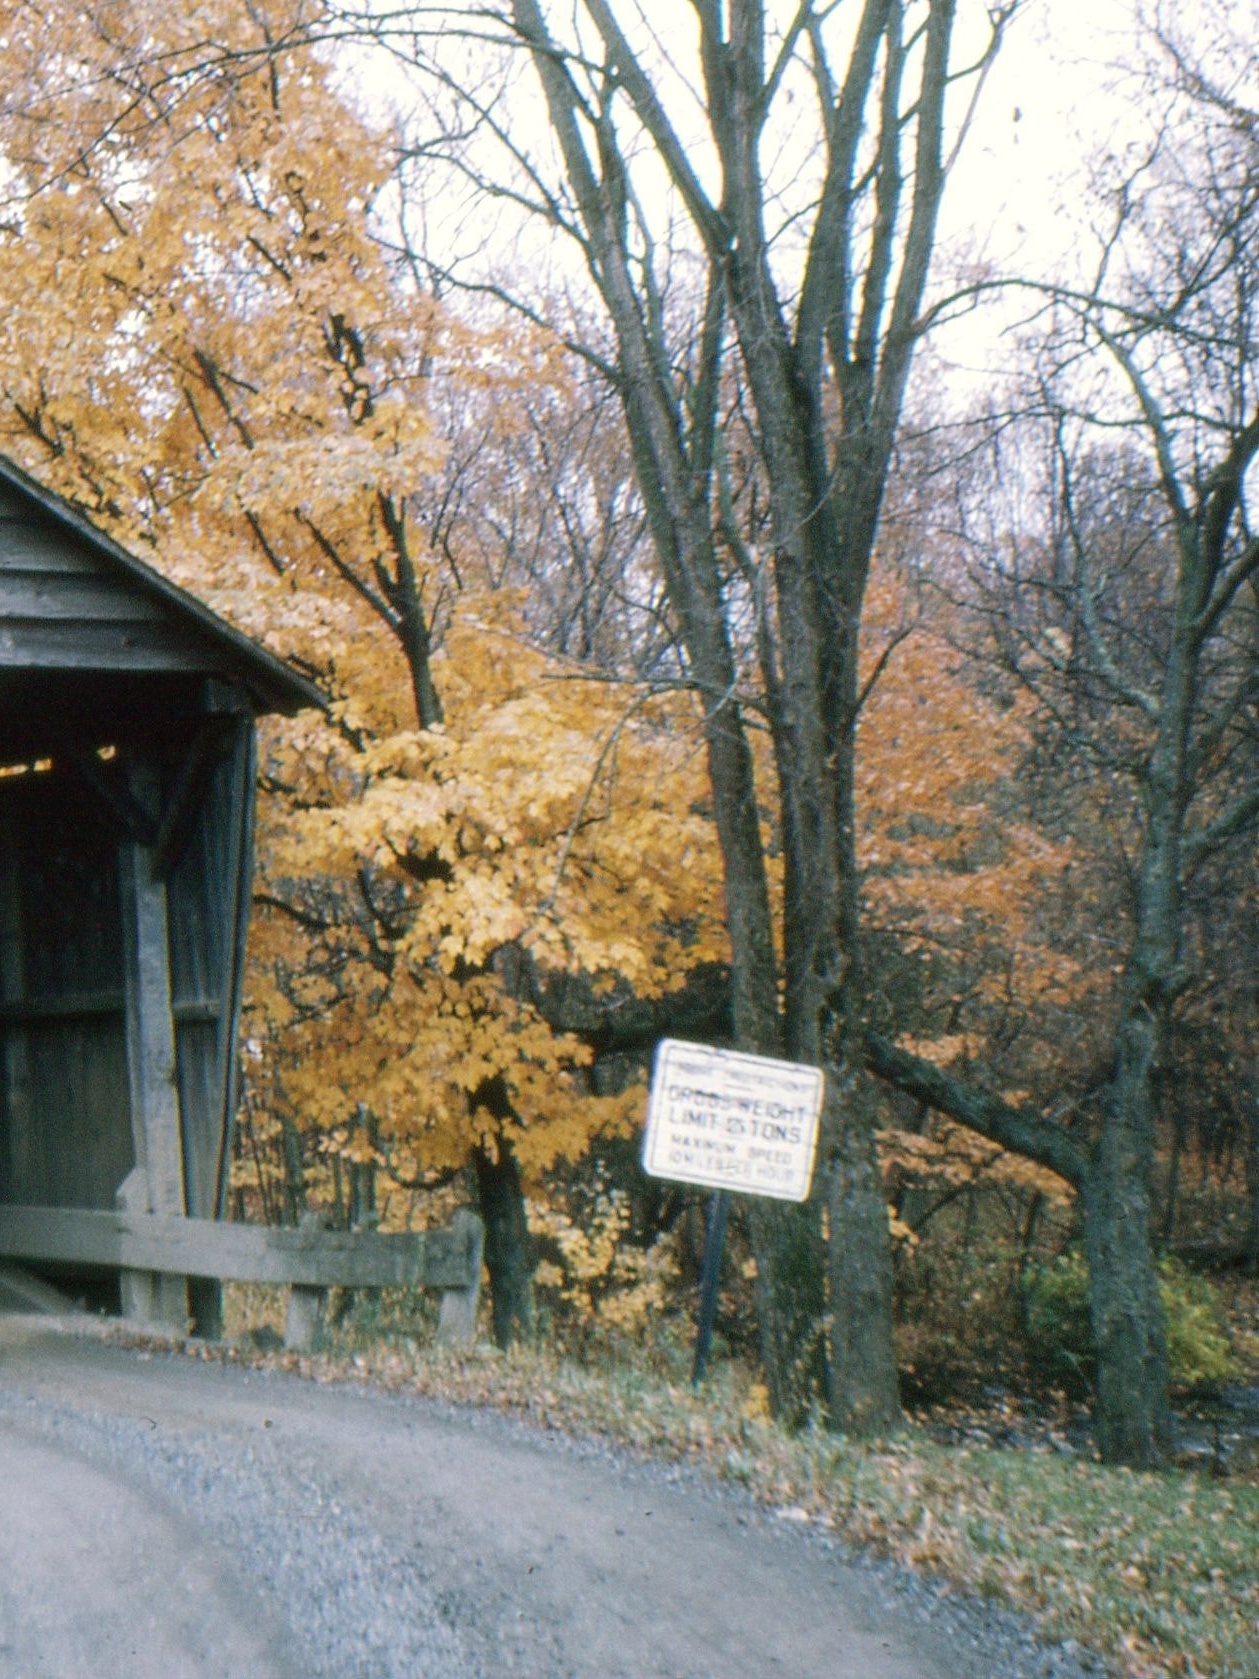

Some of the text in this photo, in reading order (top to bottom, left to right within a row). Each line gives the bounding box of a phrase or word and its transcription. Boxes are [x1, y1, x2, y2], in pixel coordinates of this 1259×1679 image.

[668, 1085, 806, 1121] GROSS WEIGHT
[669, 1107, 717, 1129] LIMIT
[750, 1120, 801, 1144] TONS
[749, 1147, 792, 1164] SPEED
